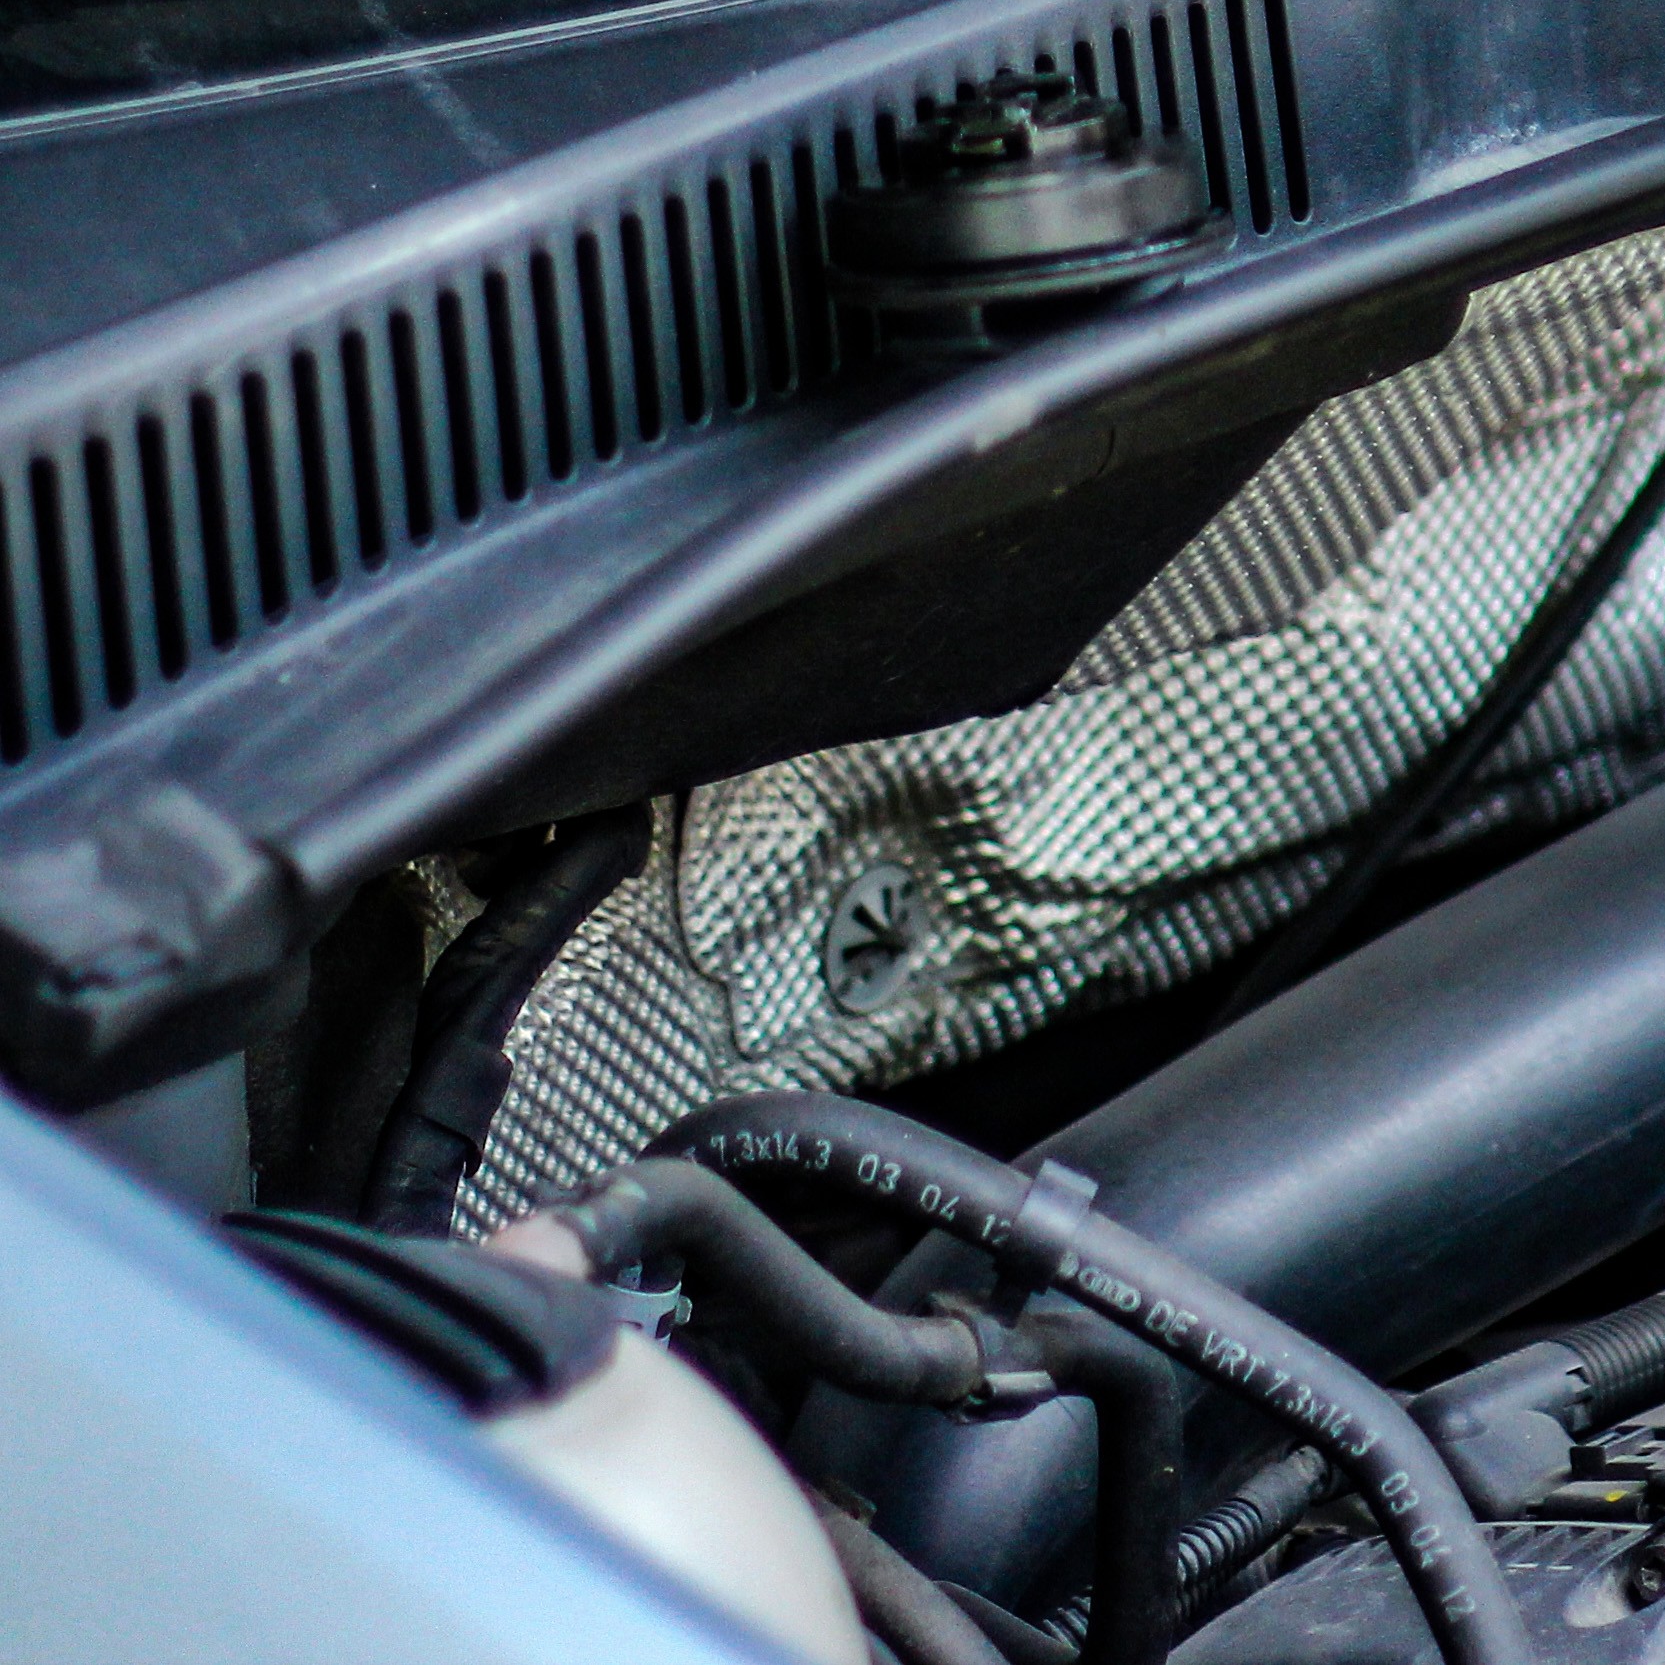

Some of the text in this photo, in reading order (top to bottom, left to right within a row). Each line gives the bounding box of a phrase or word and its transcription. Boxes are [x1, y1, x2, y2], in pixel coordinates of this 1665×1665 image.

[857, 1153, 902, 1194] 03
[919, 1183, 961, 1222] 04
[1145, 1299, 1199, 1346] DE
[1199, 1329, 1266, 1383] VRT
[1381, 1470, 1420, 1515] 03
[1409, 1525, 1451, 1569] 04
[1441, 1585, 1476, 1623] 12
